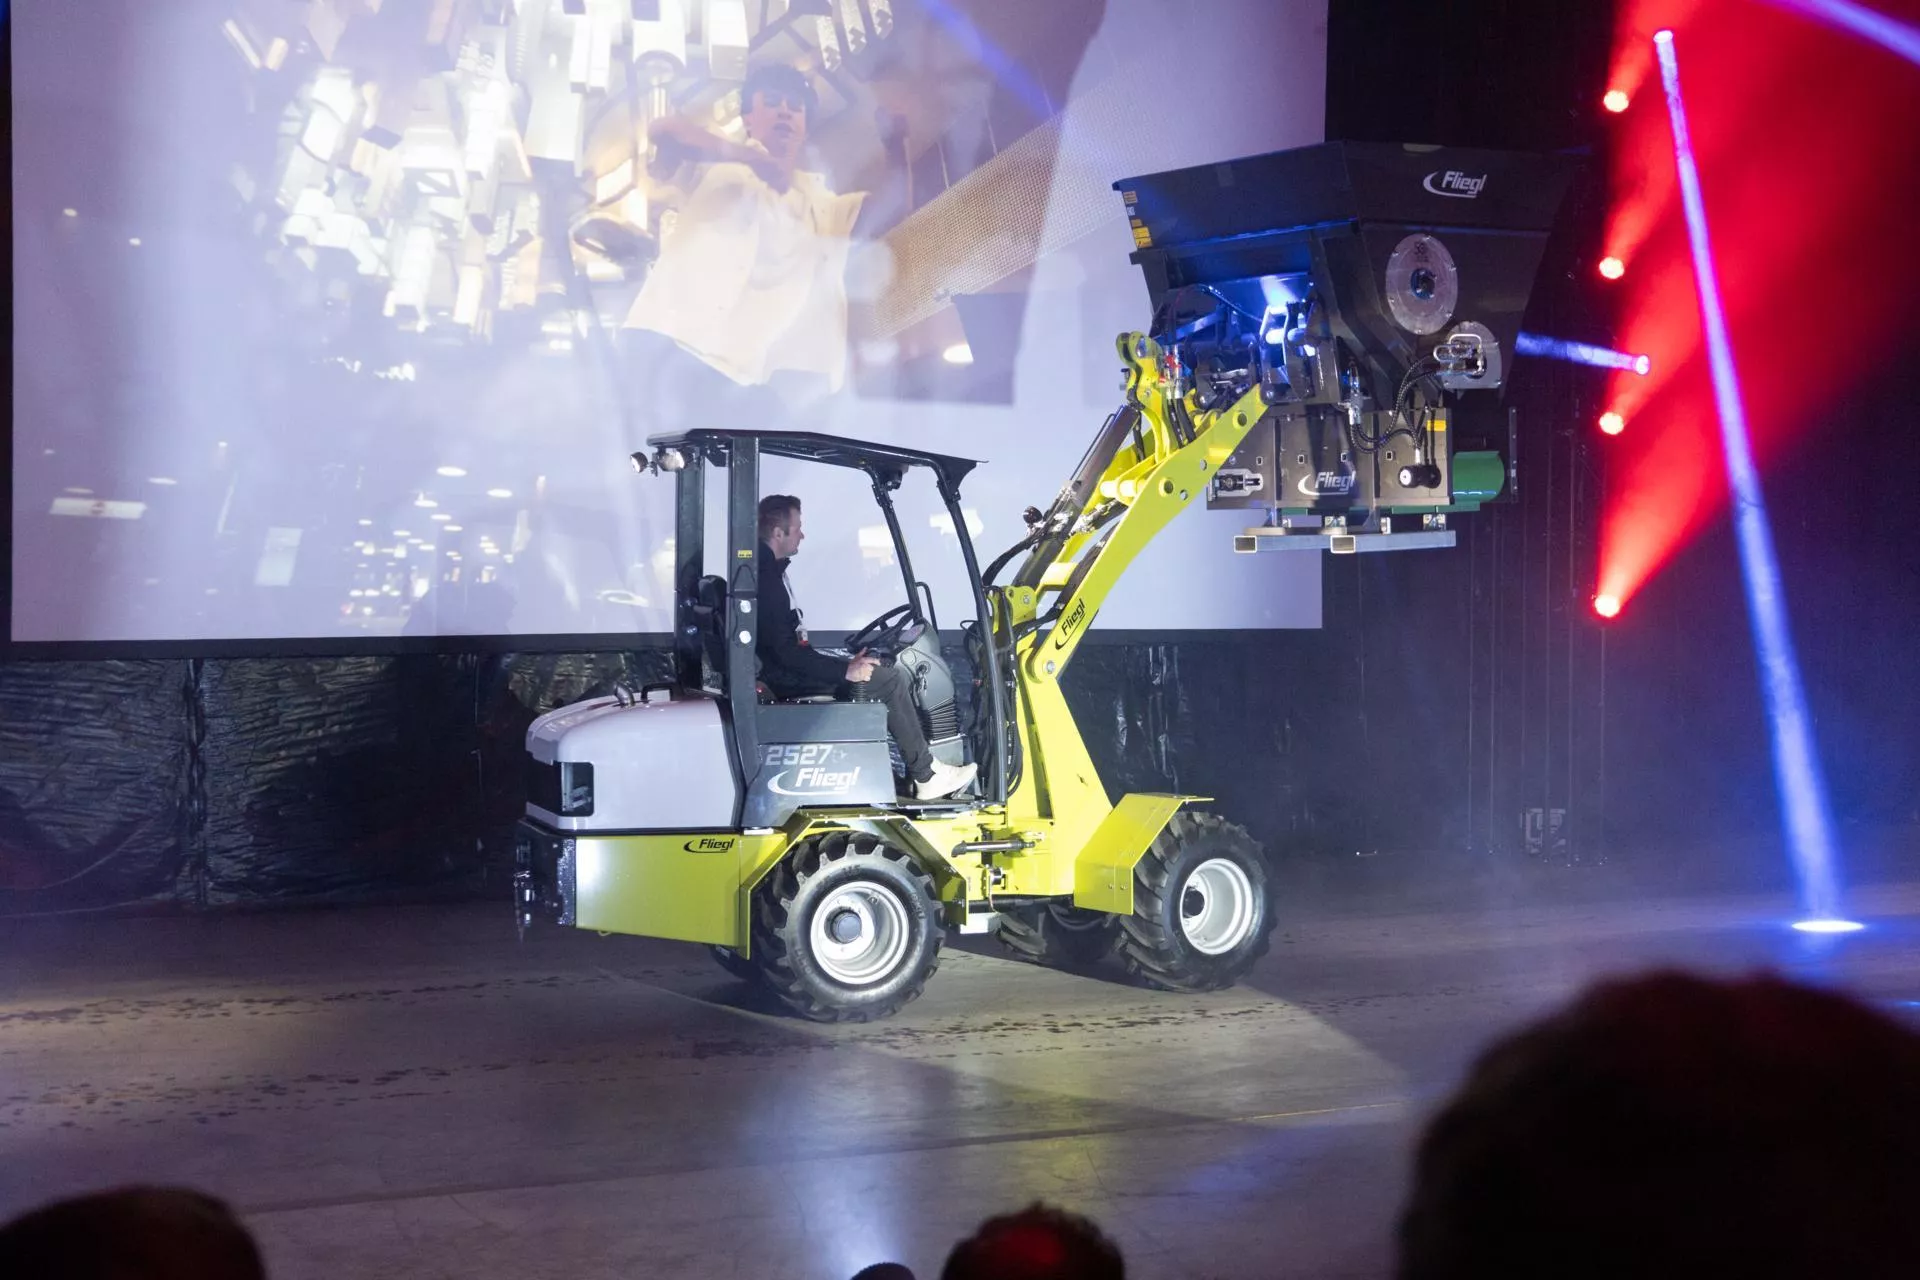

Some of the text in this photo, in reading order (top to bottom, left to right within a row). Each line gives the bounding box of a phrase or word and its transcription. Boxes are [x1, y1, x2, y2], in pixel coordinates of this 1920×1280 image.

[1442, 171, 1487, 194] Fliegl
[1315, 470, 1356, 491] Fliegl
[1061, 598, 1085, 636] Fliegl
[765, 745, 833, 765] 2527
[795, 766, 861, 791] Fliegl
[699, 838, 735, 850] Fliegl
